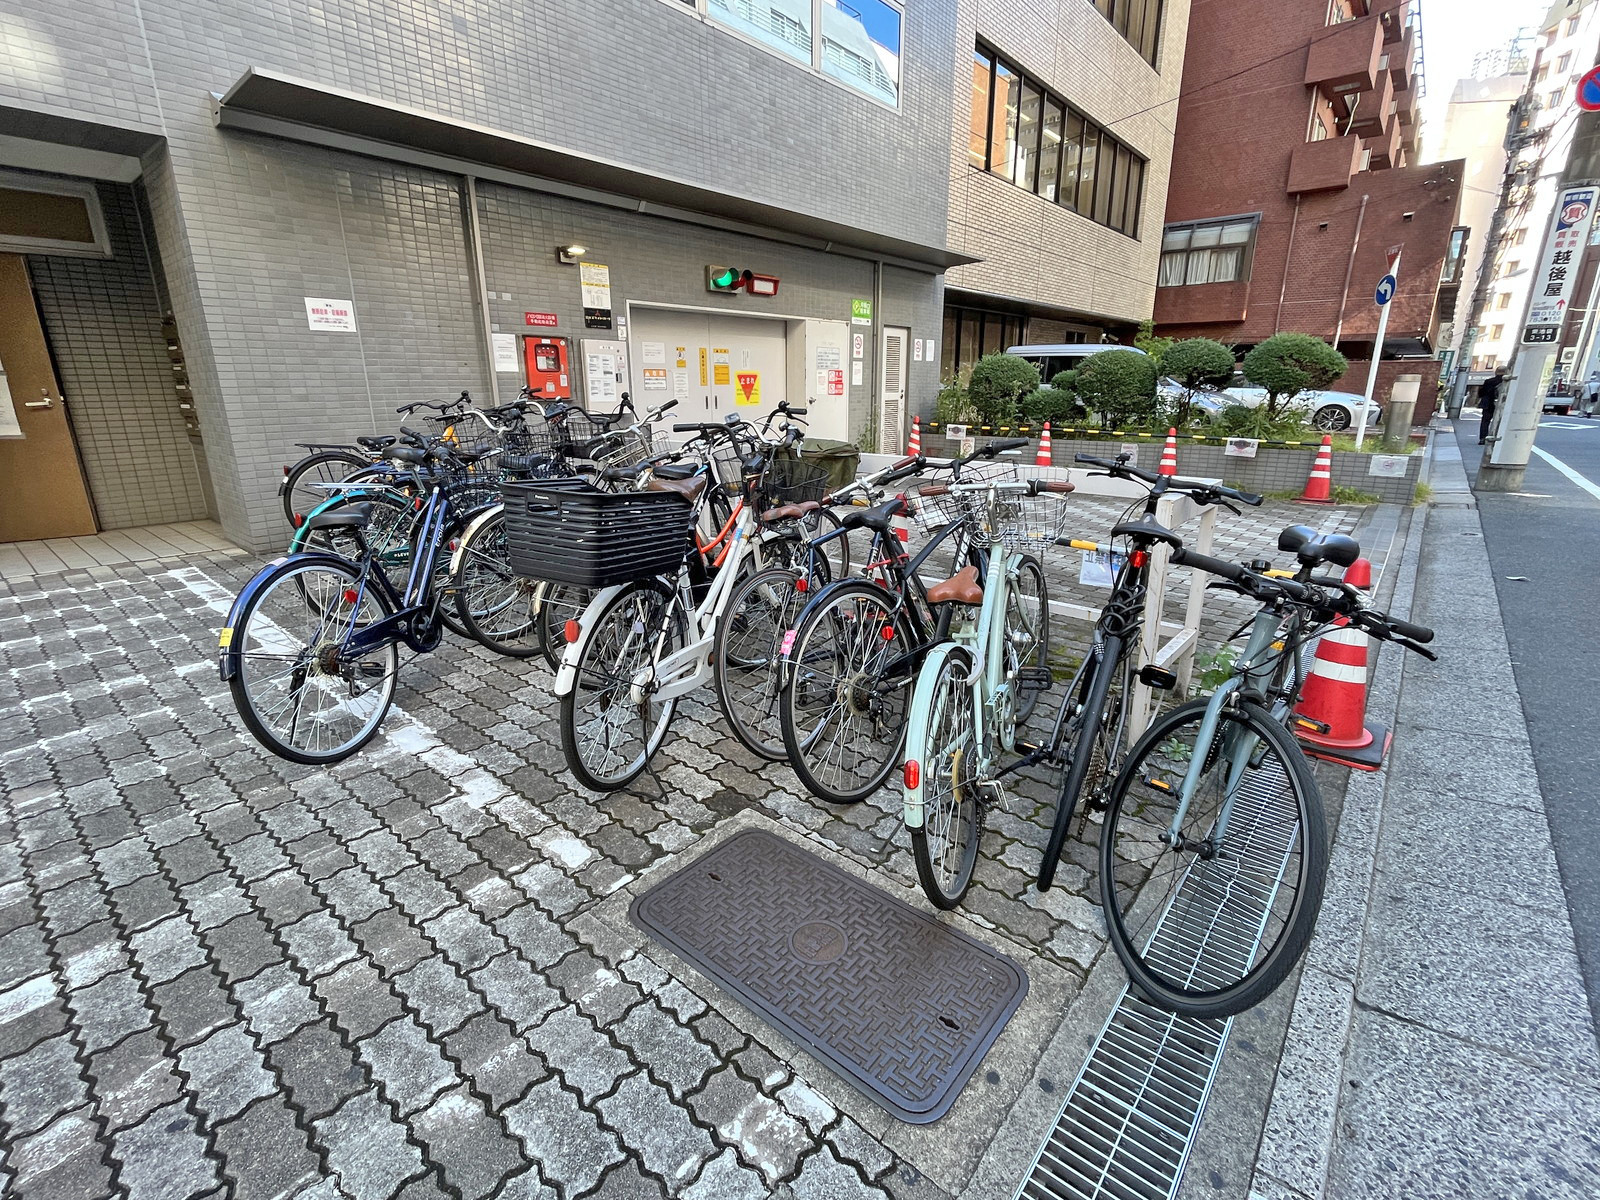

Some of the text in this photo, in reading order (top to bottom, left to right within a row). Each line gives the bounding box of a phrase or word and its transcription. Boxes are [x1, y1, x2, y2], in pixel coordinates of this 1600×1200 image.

[1543, 250, 1573, 297] 越後屋
[740, 376, 755, 385] 止まれ
